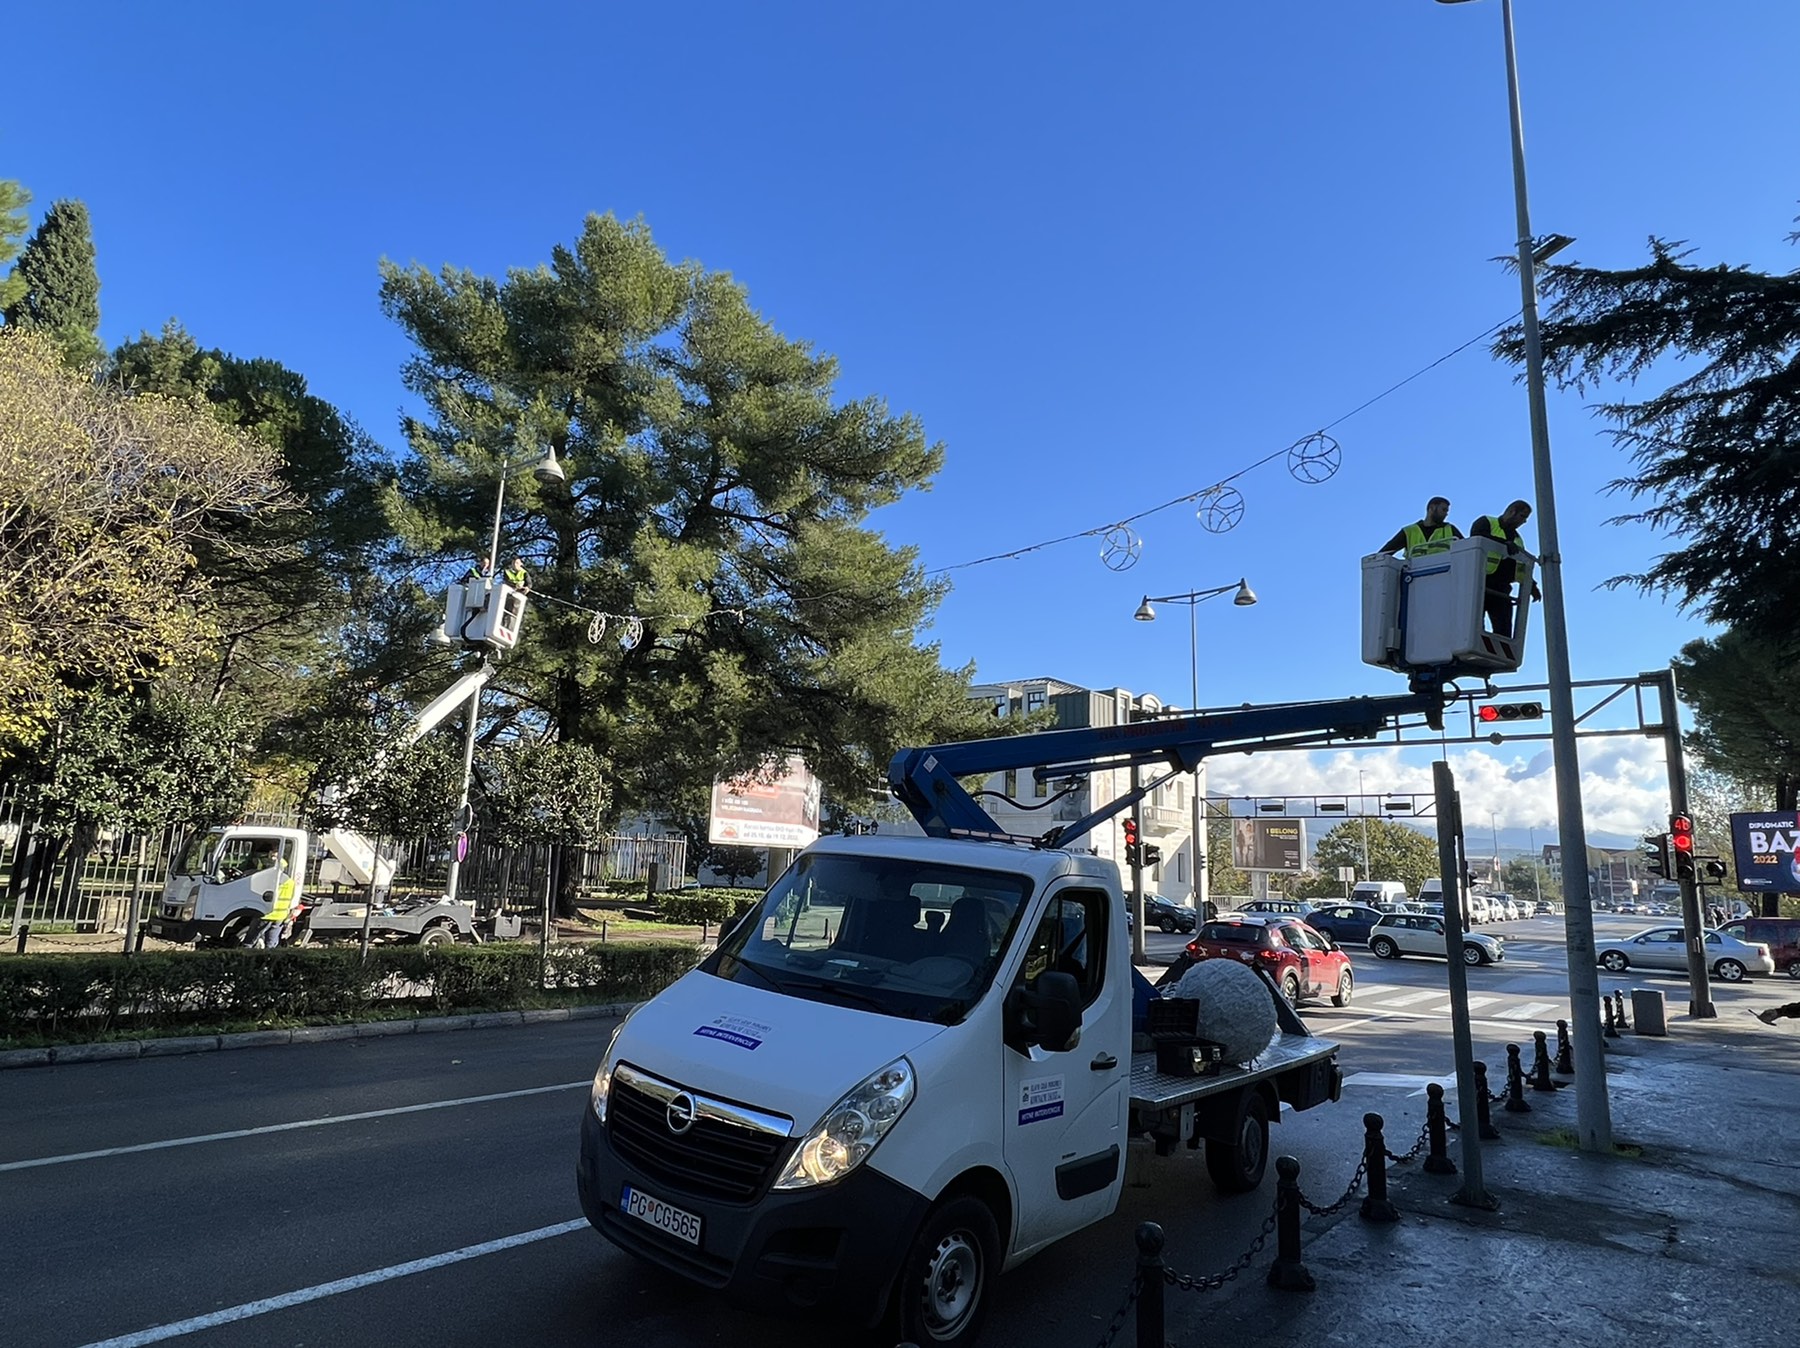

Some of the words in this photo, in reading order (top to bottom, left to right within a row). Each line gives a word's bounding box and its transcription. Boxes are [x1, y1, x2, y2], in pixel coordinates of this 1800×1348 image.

[1748, 821, 1794, 829] DIPLOMATIC
[1269, 827, 1298, 835] BELONG
[1753, 855, 1778, 864] 2022
[629, 1191, 648, 1216] PG
[653, 1202, 700, 1240] CG565
